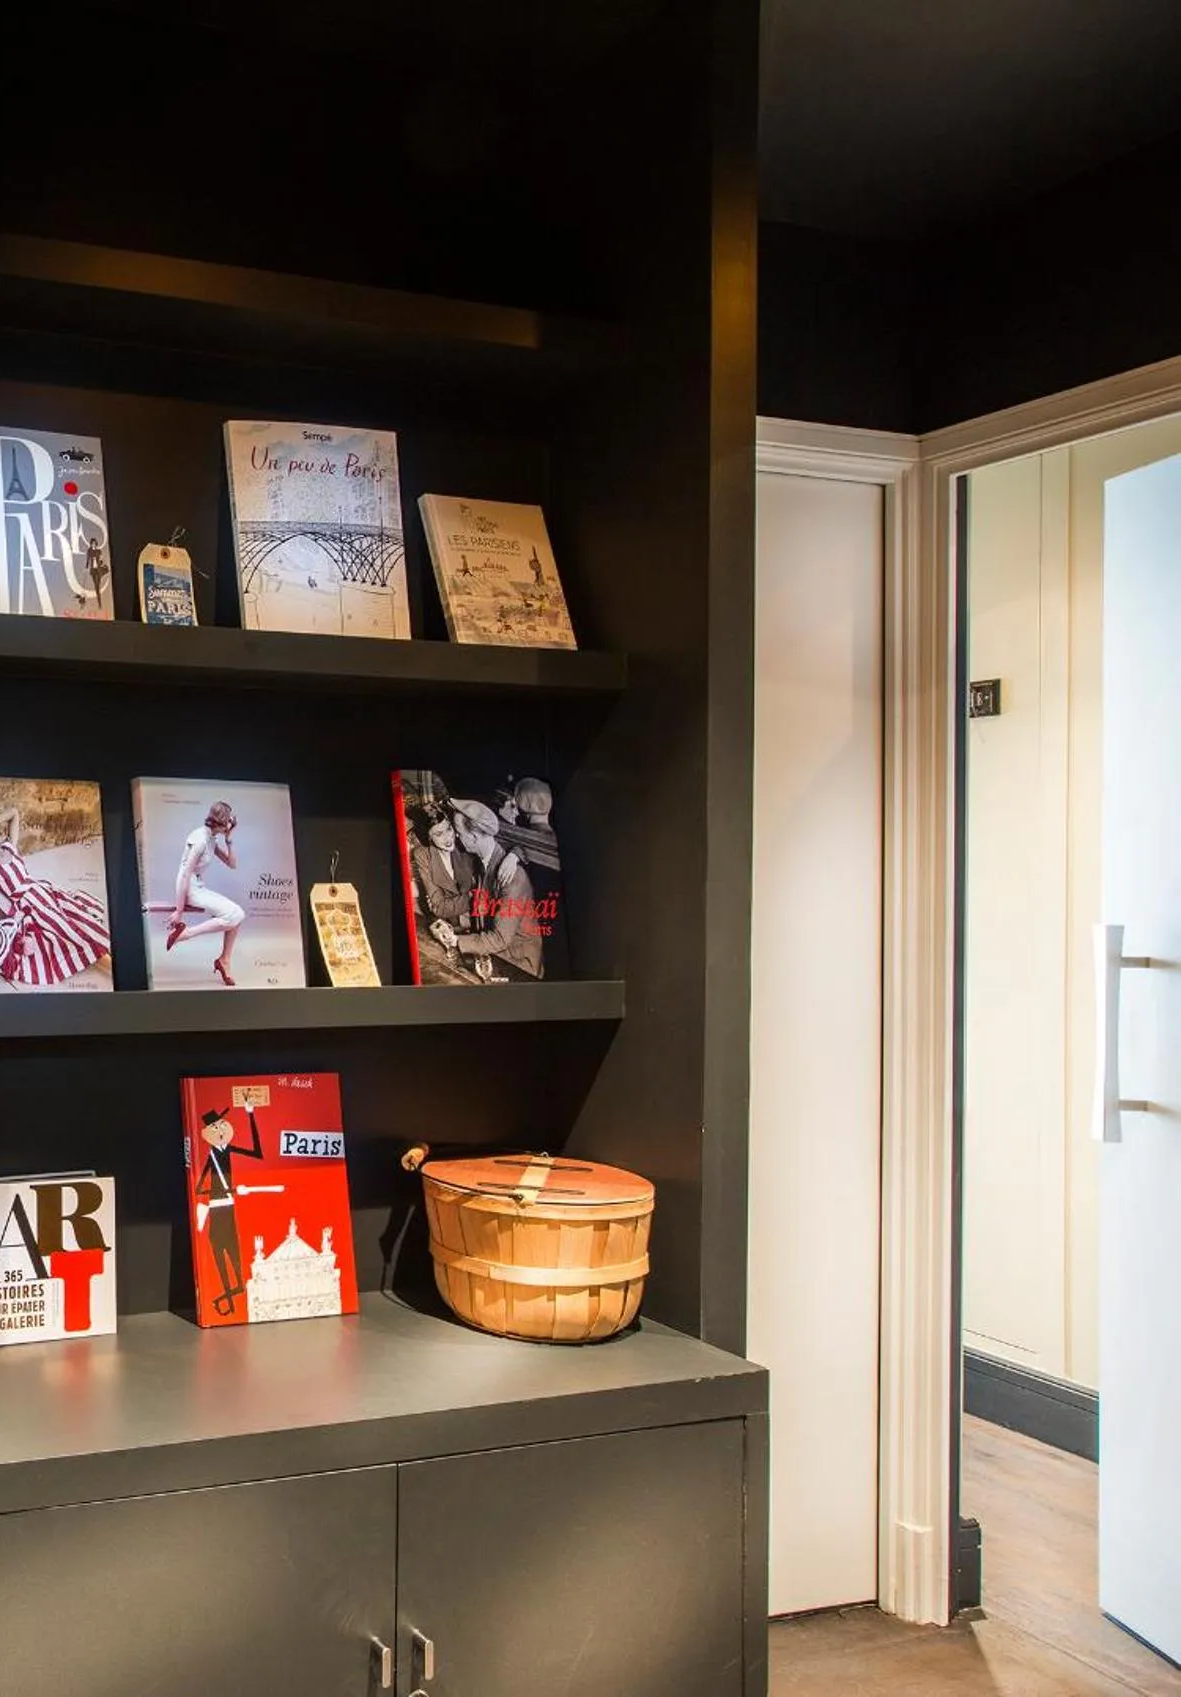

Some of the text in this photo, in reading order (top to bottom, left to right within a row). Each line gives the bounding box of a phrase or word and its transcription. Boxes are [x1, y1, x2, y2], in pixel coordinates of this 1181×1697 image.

[303, 430, 334, 442] Sempé
[250, 446, 388, 483] Un peu de Paris
[447, 533, 468, 546] LES
[258, 873, 294, 887] Shoes
[249, 890, 294, 904] vintage
[283, 1132, 343, 1155] Paris
[4, 1270, 23, 1283] 365
[0, 1314, 46, 1331] GALERIE
